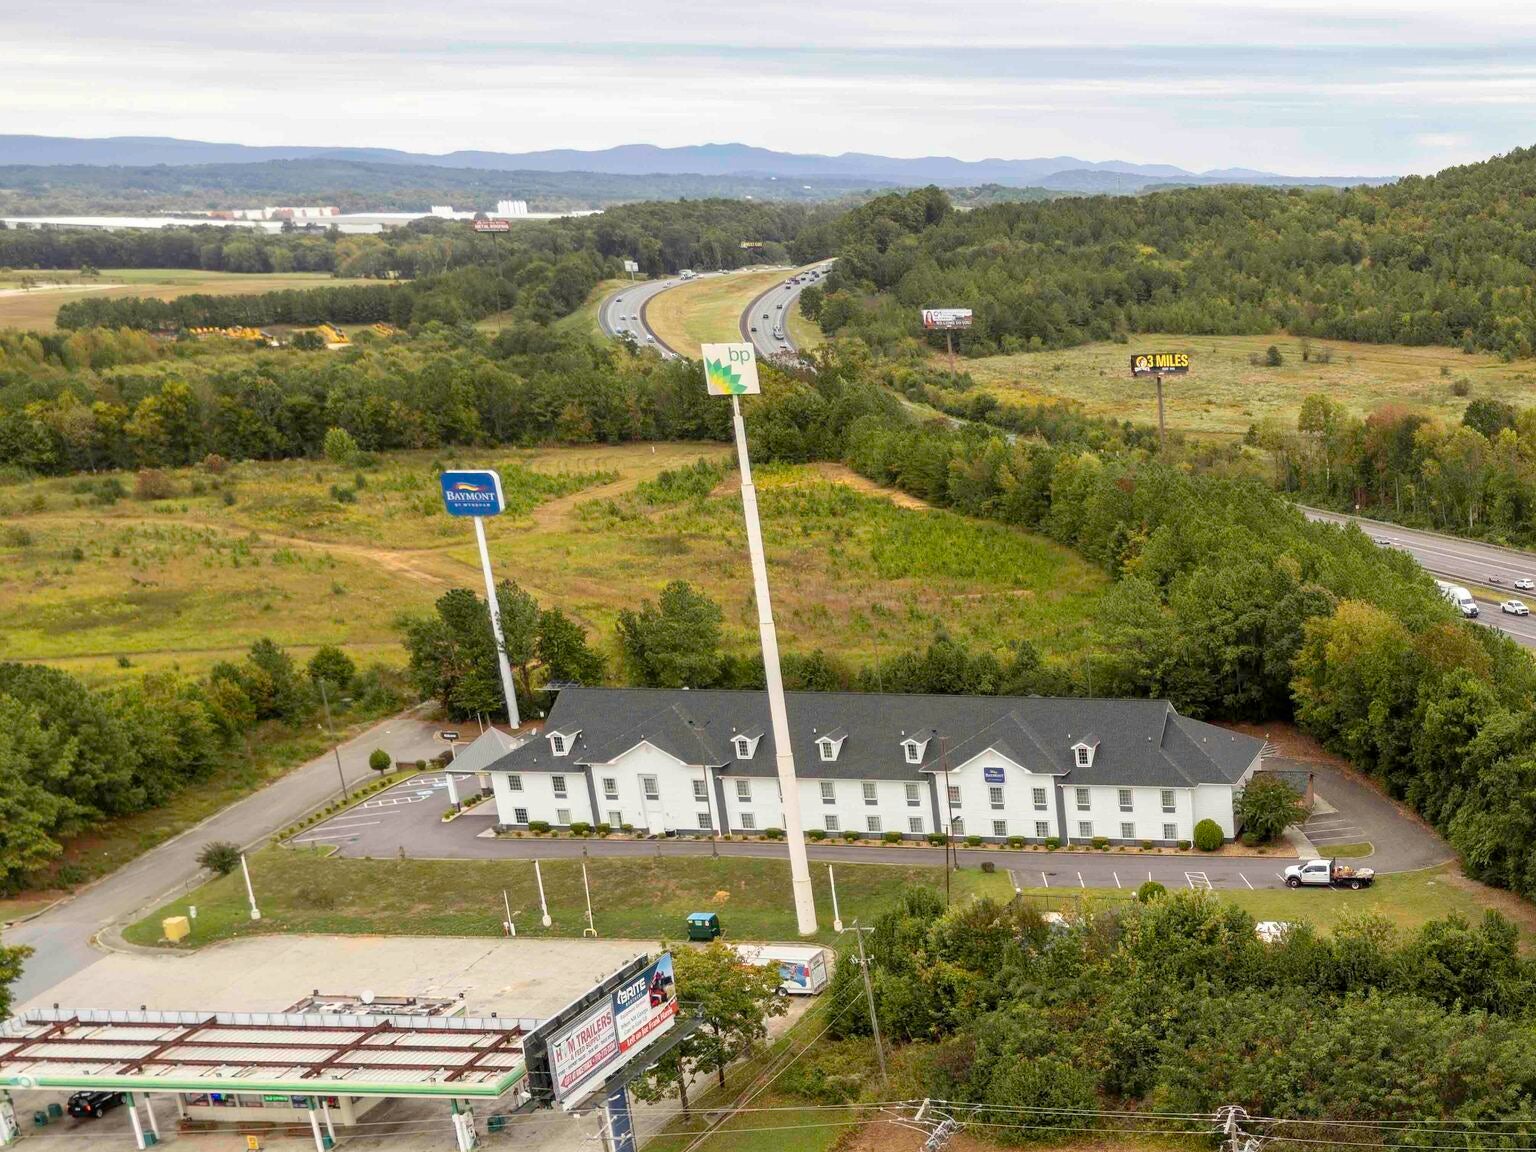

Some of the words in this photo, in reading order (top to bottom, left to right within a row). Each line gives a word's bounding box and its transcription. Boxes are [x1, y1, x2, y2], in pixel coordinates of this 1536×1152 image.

[728, 346, 751, 365] bp
[1147, 354, 1154, 367] 3
[1156, 354, 1189, 367] MILES
[446, 490, 496, 501] BAYMONT
[620, 977, 646, 1005] BRITE
[576, 1011, 612, 1047] TRAILERS
[575, 1045, 586, 1057] FEED
